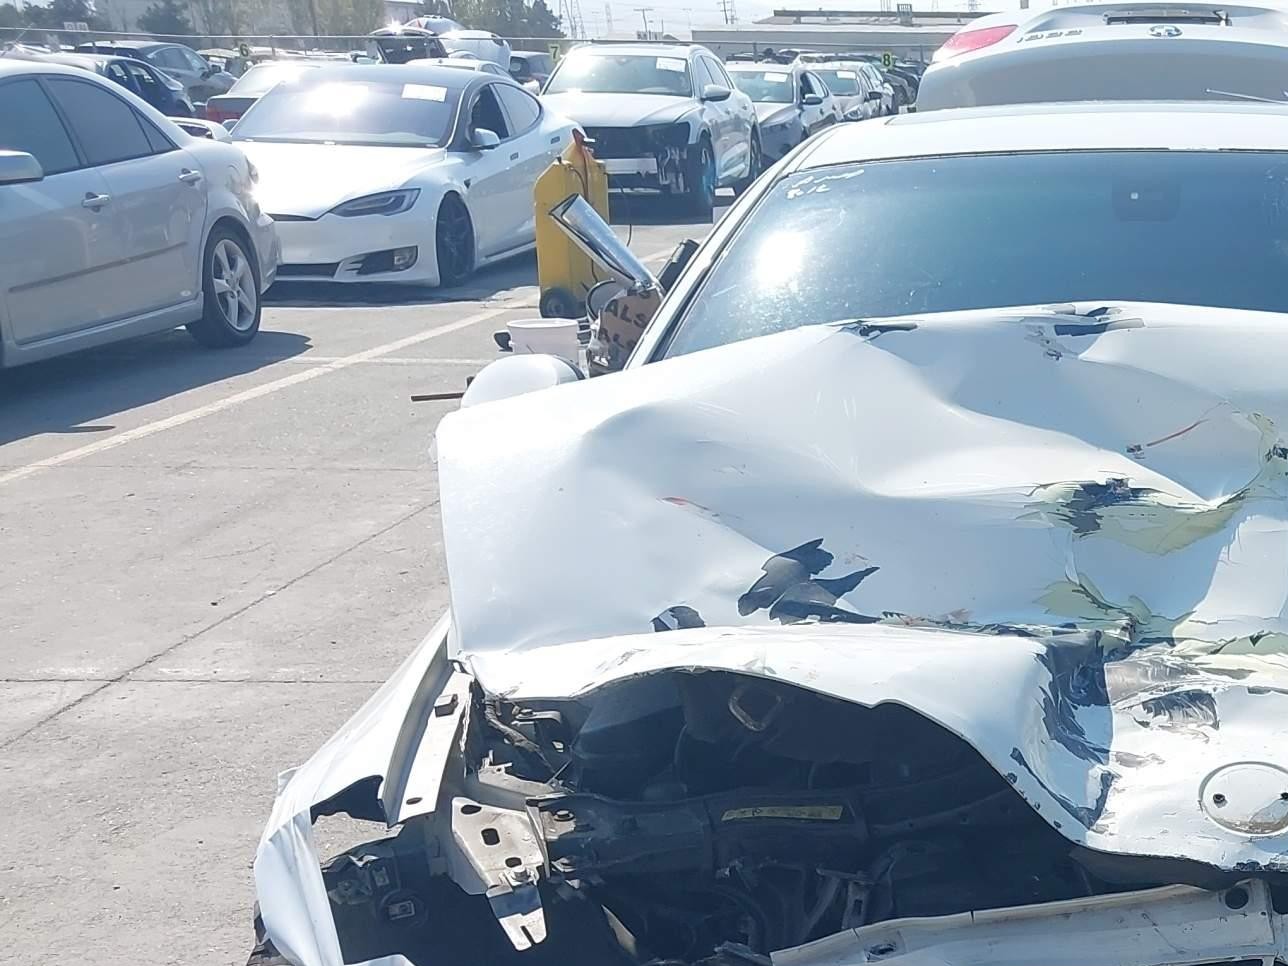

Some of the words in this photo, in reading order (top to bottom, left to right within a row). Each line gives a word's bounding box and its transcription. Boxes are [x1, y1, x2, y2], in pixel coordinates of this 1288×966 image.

[240, 43, 249, 57] 6
[550, 45, 559, 59] 7
[883, 53, 891, 67] 8
